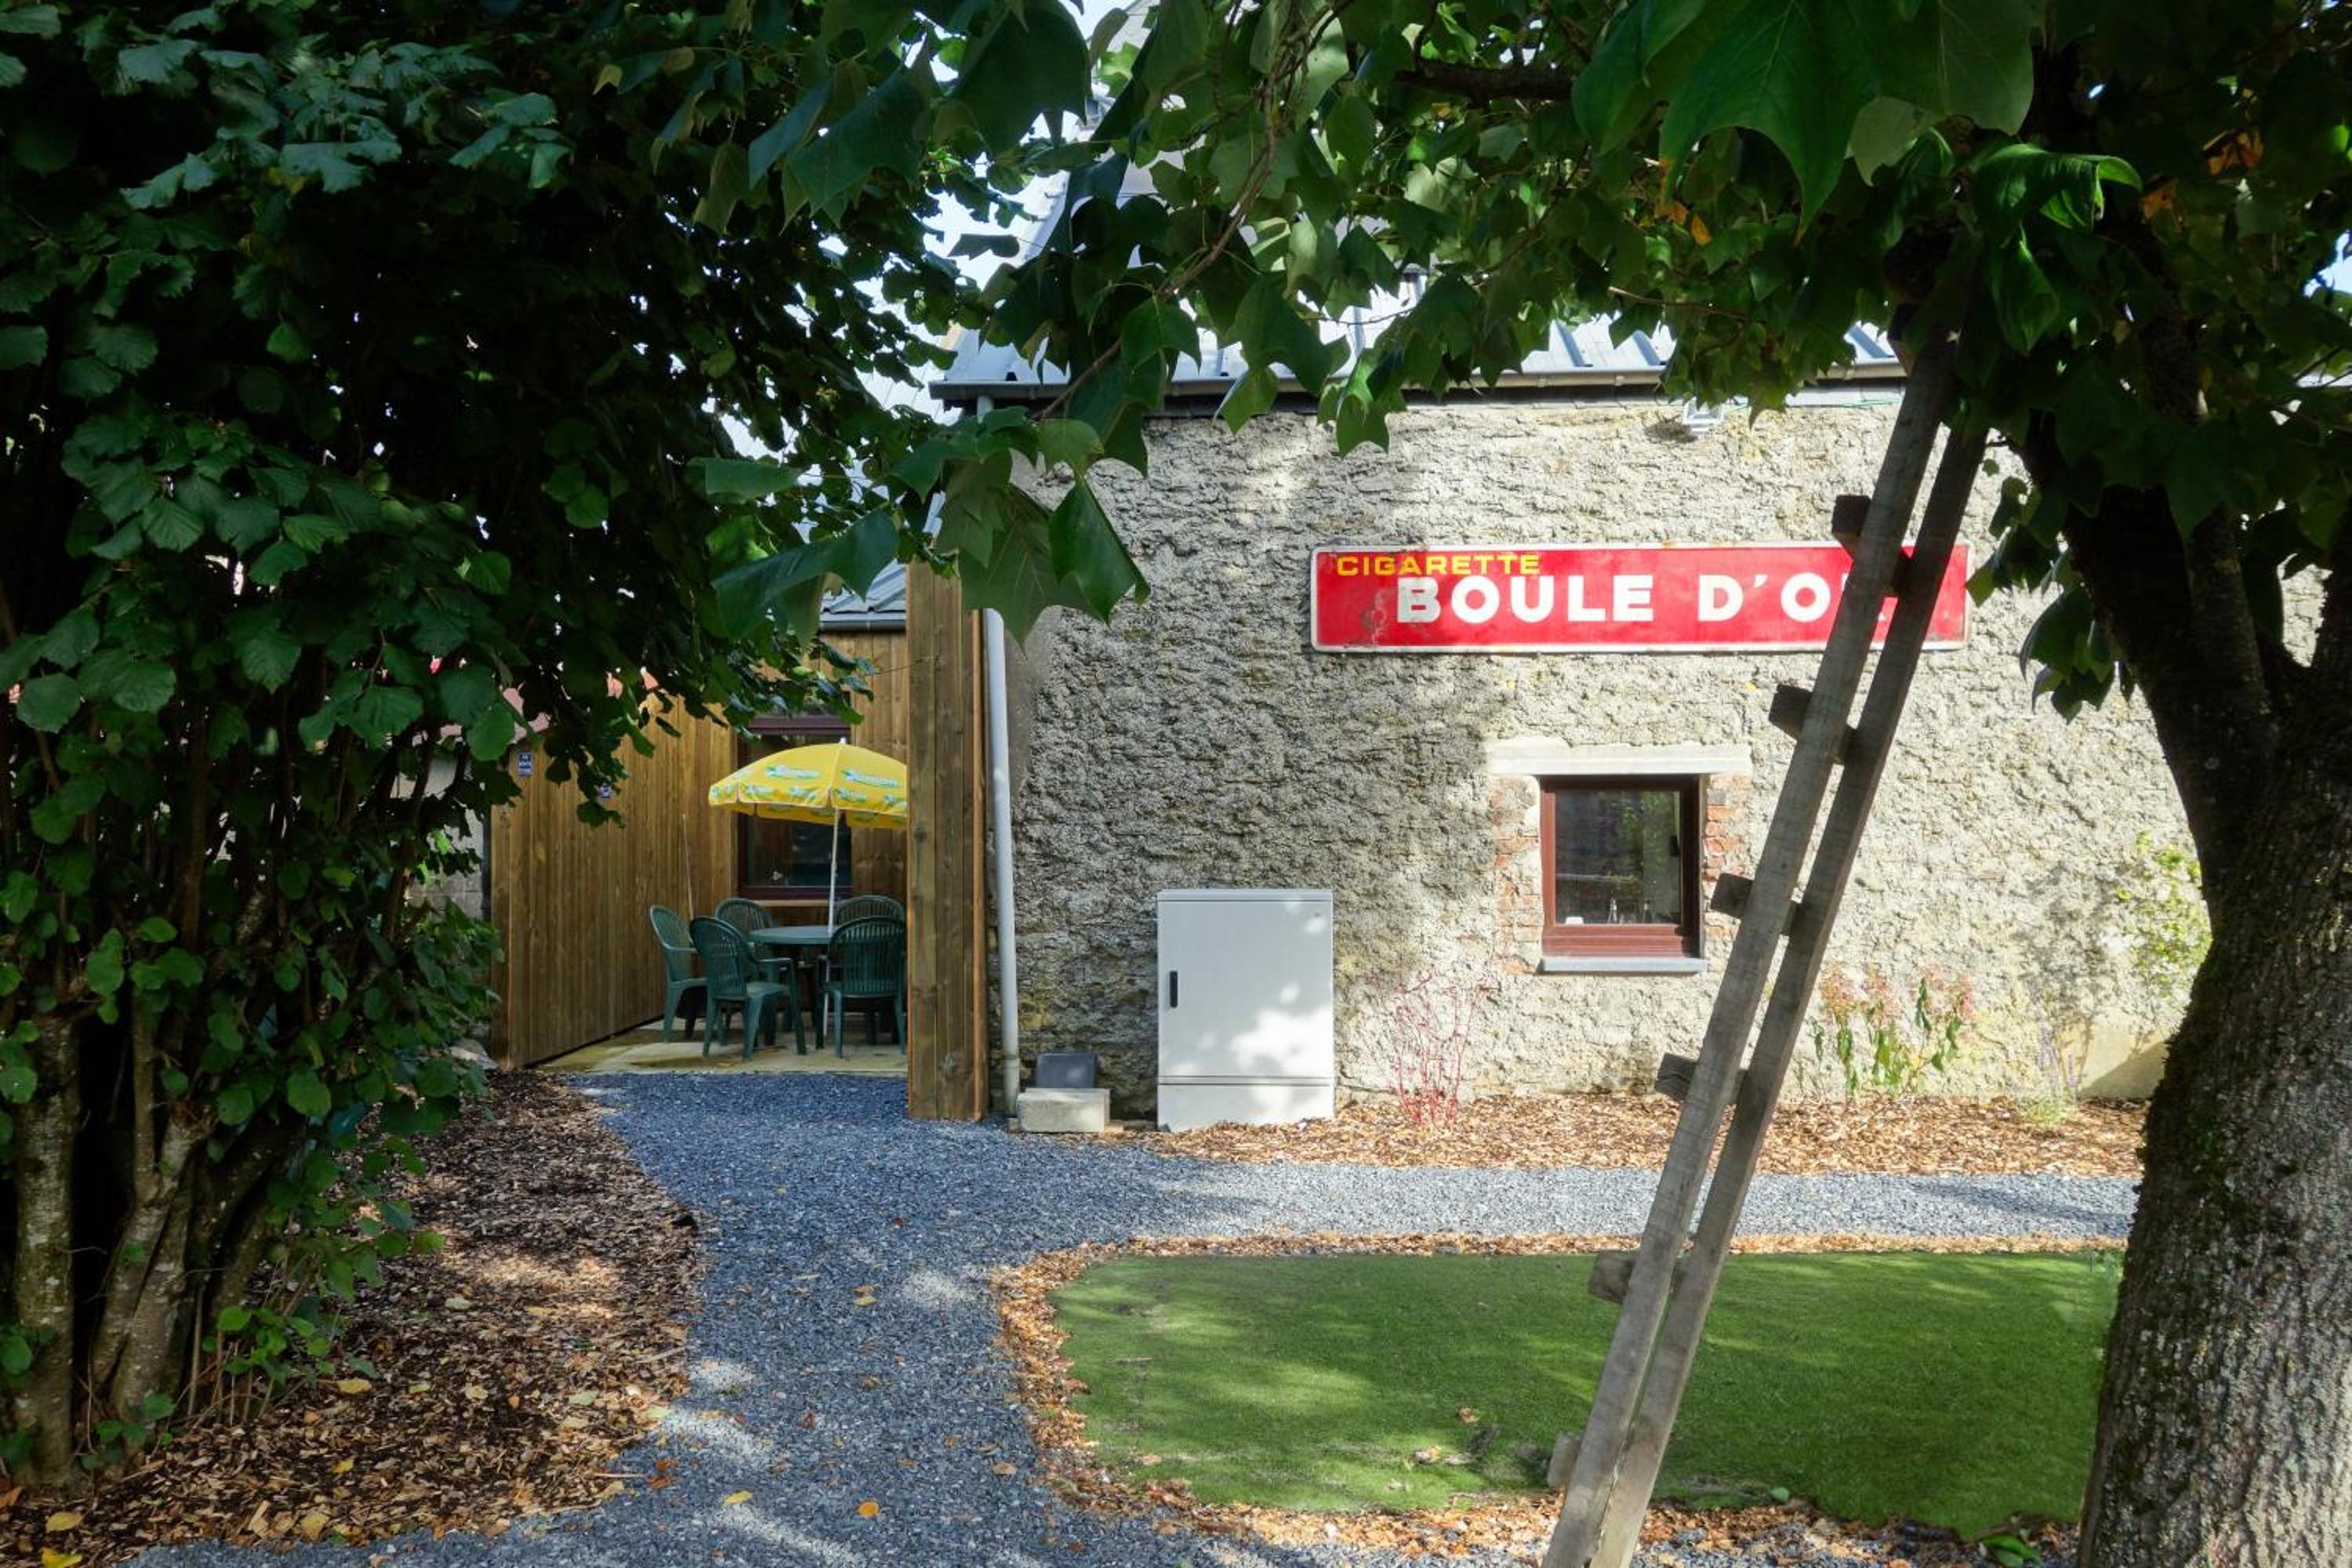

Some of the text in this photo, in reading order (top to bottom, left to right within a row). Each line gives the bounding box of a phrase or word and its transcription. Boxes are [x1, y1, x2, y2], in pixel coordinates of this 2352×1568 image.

[1336, 554, 1541, 576] CIGARETTE
[1397, 572, 1887, 624] BOULE D'O
